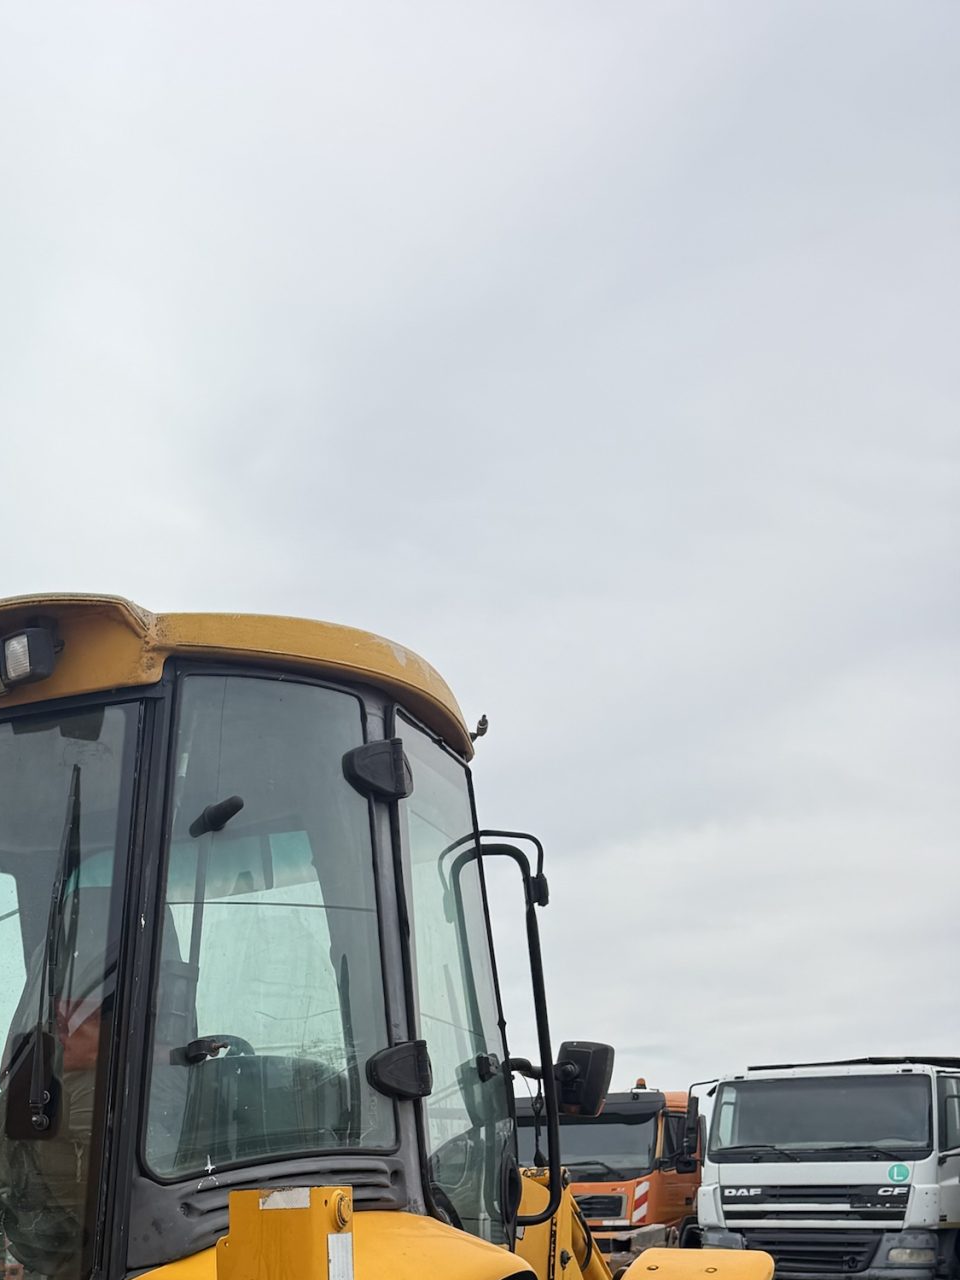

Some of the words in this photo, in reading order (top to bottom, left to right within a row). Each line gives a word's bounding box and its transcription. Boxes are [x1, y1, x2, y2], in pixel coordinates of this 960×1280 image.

[893, 1166, 904, 1180] L
[723, 1188, 762, 1196] DAF
[877, 1187, 908, 1196] CF
